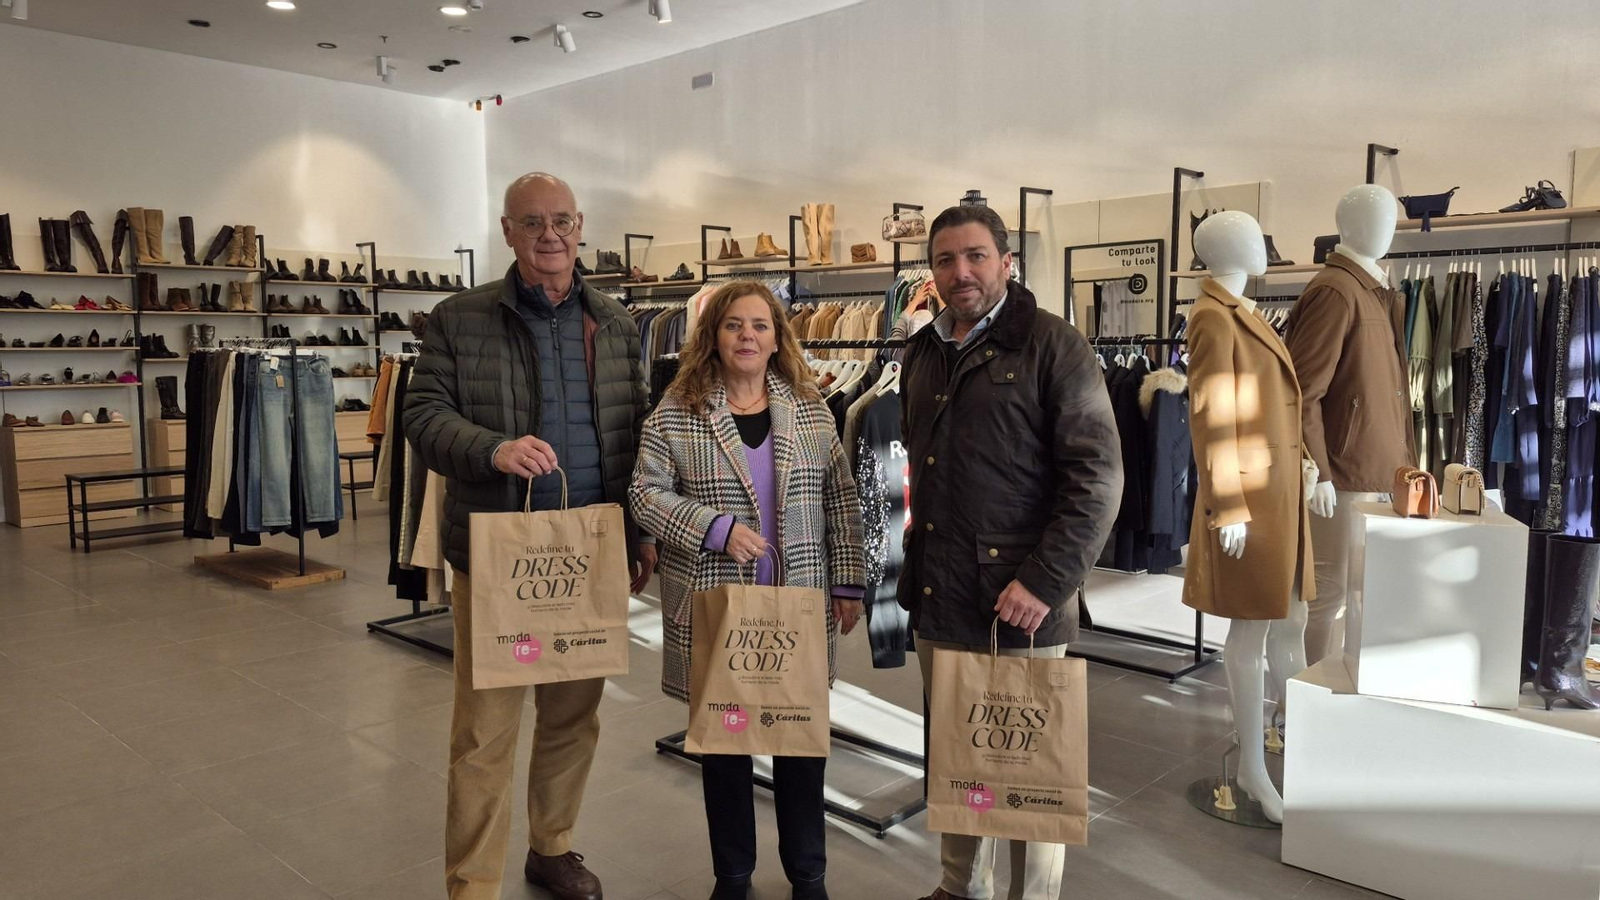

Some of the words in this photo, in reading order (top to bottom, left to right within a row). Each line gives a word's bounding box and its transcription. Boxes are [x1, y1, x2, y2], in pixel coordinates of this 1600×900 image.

[1108, 245, 1156, 257] Comparte
[1122, 259, 1131, 267] tu
[1135, 257, 1156, 265] look
[526, 545, 562, 555] Redefine
[564, 545, 574, 553] tu
[511, 555, 590, 579] DRESS
[516, 577, 586, 601] CODE
[740, 617, 774, 628] Redefine
[775, 618, 785, 628] tu
[497, 632, 531, 644] moda
[724, 629, 799, 651] DRESS
[728, 651, 793, 672] CODE
[983, 691, 1021, 704] Redefine
[1023, 693, 1033, 704] tu
[707, 702, 740, 713] moda
[967, 703, 1049, 729] DRESS
[971, 727, 1043, 753] CODE
[950, 780, 985, 791] moda
